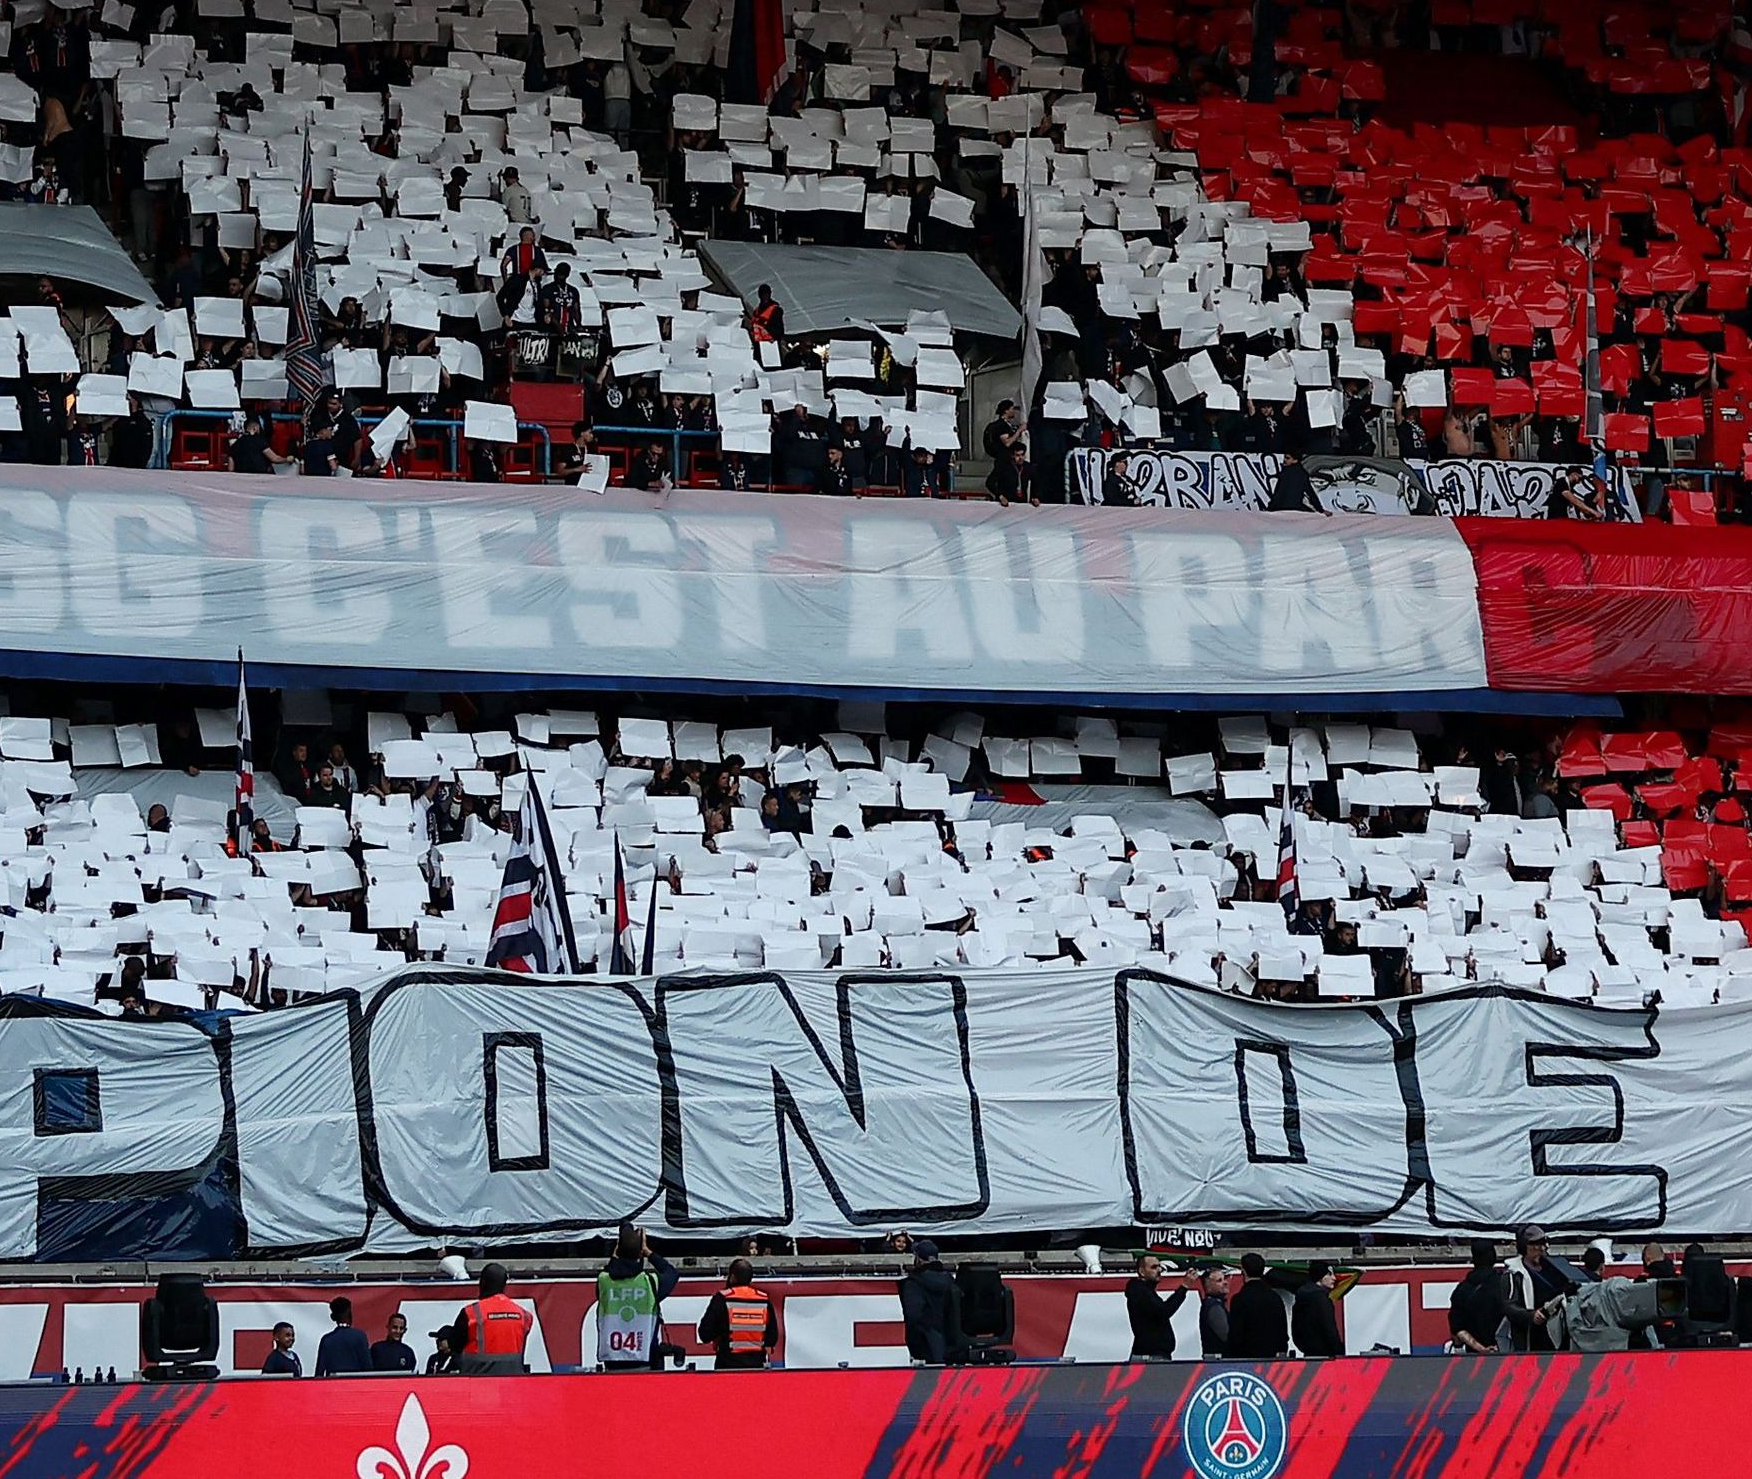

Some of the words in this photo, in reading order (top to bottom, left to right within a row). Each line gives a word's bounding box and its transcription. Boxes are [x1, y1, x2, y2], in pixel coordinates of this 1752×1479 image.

[258, 495, 788, 661] C'EST
[849, 522, 1085, 665] AU
[1115, 967, 1669, 1231] DE
[609, 1288, 646, 1301] LFP
[610, 1331, 636, 1351] 04
[1200, 1377, 1267, 1408] PARIS
[1203, 1458, 1228, 1479] SAINT
